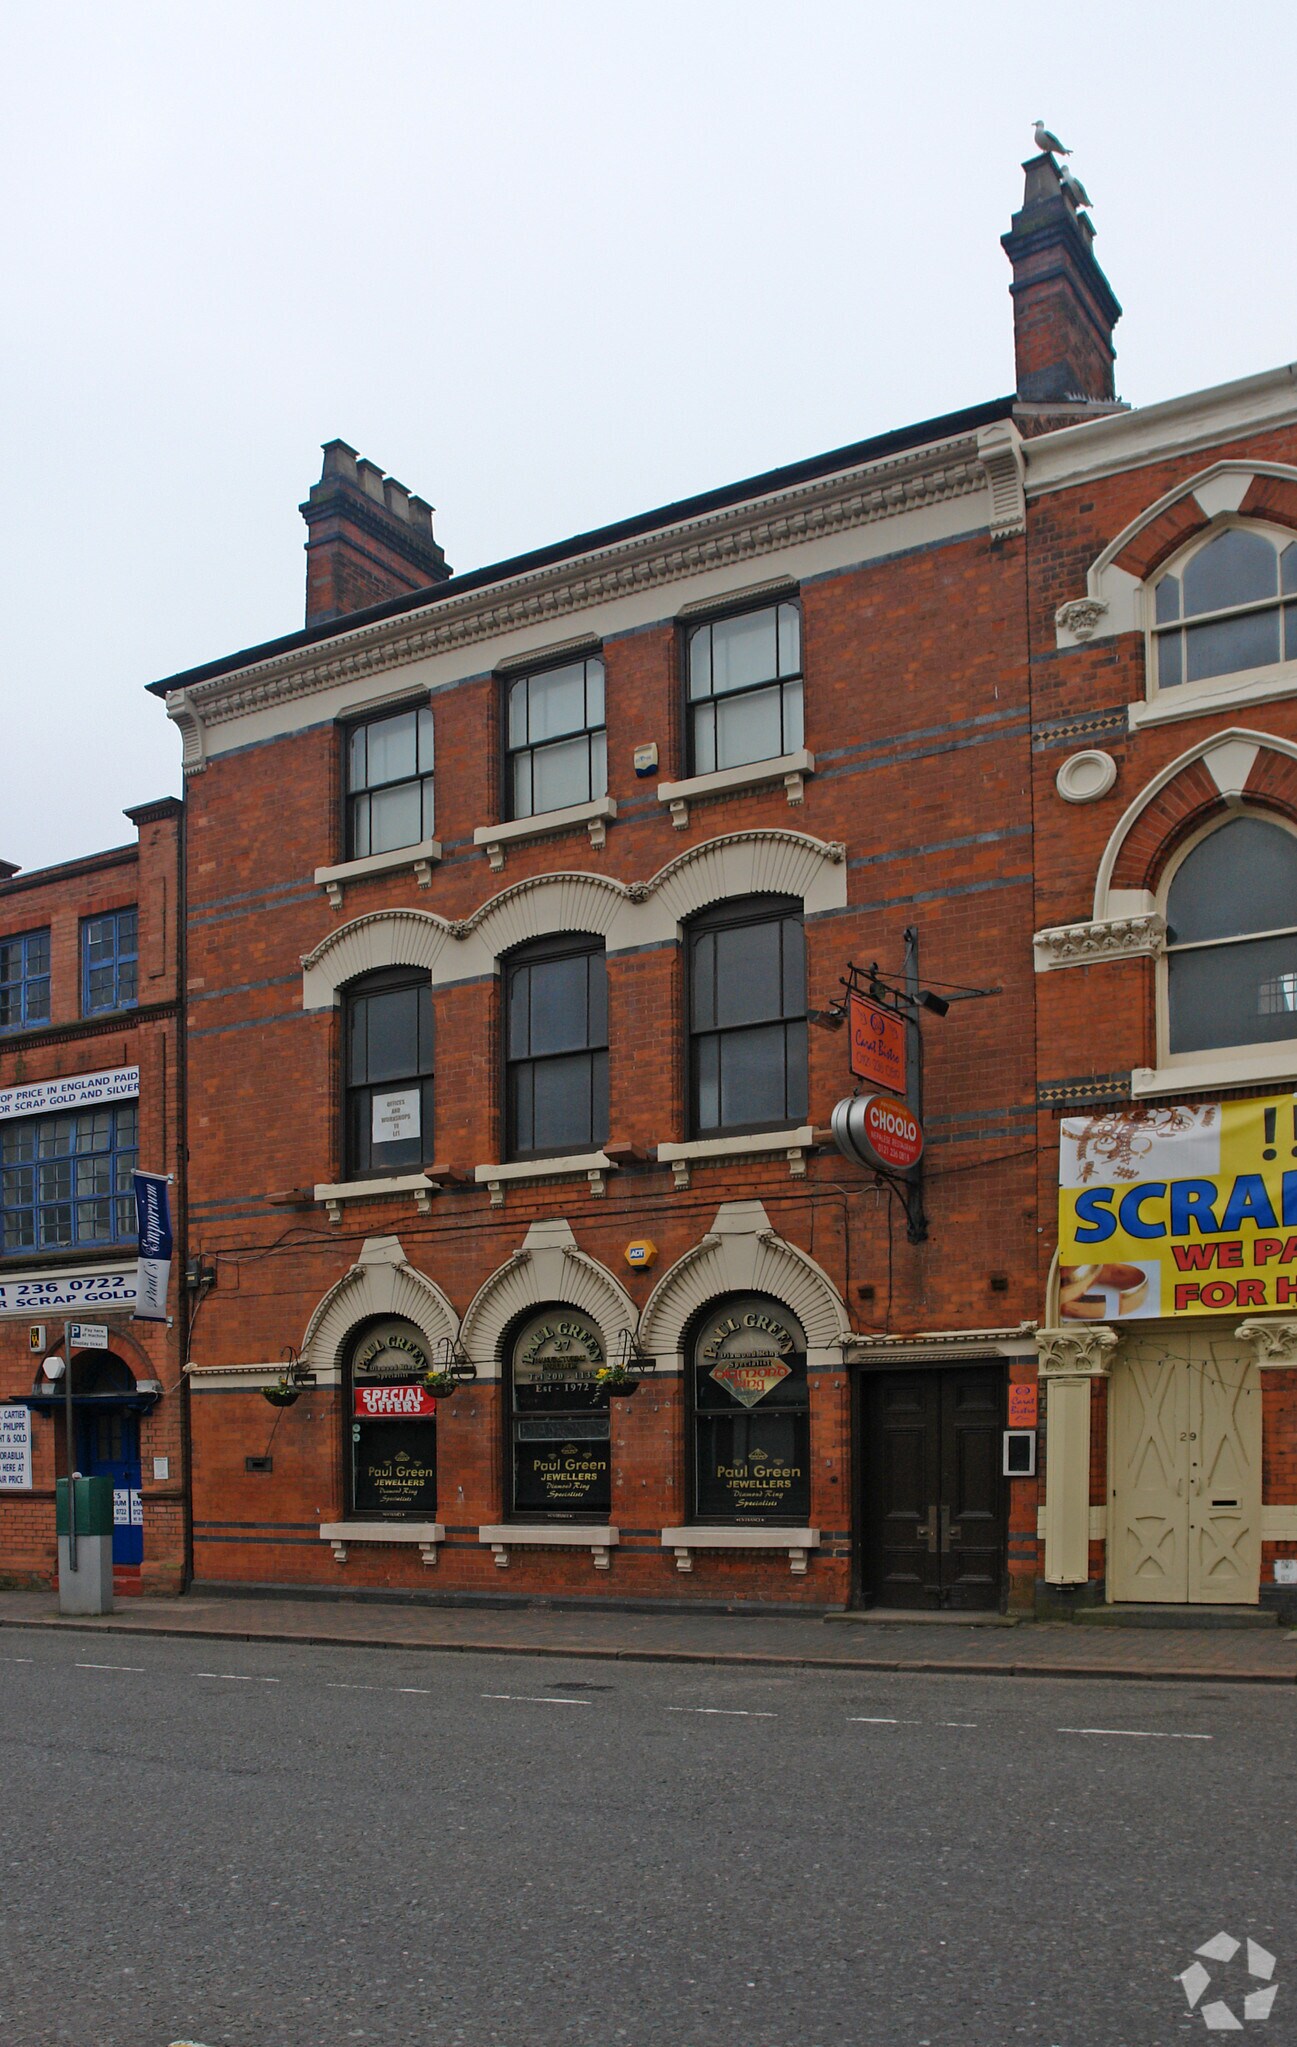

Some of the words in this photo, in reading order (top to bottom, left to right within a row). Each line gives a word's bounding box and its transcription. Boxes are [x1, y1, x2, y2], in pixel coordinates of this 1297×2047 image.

[16, 1088, 43, 1100] PRICE
[47, 1086, 57, 1094] IN
[61, 1077, 110, 1092] ENGLAND
[114, 1072, 138, 1082] PAID
[14, 1099, 46, 1111] SCRAP
[49, 1094, 76, 1105] GOLD
[80, 1089, 103, 1100] AND
[106, 1082, 139, 1096] SILVER
[870, 1106, 917, 1142] CHOOLO
[630, 1249, 644, 1257] ADT
[1171, 1240, 1244, 1272] WE
[18, 1282, 58, 1295] 236
[69, 1276, 125, 1291] 0722
[16, 1294, 77, 1307] SCRAP
[84, 1289, 137, 1301] GOLD
[1174, 1279, 1268, 1311] FOR
[704, 1318, 741, 1359] PAUL
[743, 1313, 796, 1355] GREEN
[523, 1326, 555, 1365] PAUL
[557, 1322, 604, 1362] GREEN
[554, 1339, 571, 1351] 27
[357, 1339, 386, 1372] PAUL
[386, 1335, 428, 1369] GREEN
[728, 1359, 772, 1369] Specialist
[547, 1372, 564, 1380] 200
[535, 1384, 553, 1393] Est
[564, 1383, 590, 1392] 1972
[362, 1388, 424, 1403] SPECIAL
[366, 1400, 421, 1413] OFFERS
[4, 1410, 26, 1419] CARTIER
[3, 1422, 25, 1431] PHILIPPE
[7, 1434, 11, 1443] &
[13, 1434, 27, 1443] SOLD
[1180, 1432, 1197, 1442] 29
[2, 1463, 16, 1472] HERE
[18, 1463, 24, 1472] AT
[533, 1459, 561, 1471] Paul
[564, 1459, 607, 1471] Green
[368, 1466, 392, 1477] Paul
[396, 1466, 433, 1477] Green
[717, 1465, 748, 1478] Paul
[753, 1465, 801, 1478] Green
[8, 1475, 24, 1484] PRICE
[540, 1473, 598, 1481] JEWELLERS
[374, 1479, 425, 1487] JEWELLERS
[573, 1482, 590, 1491] Ring
[726, 1480, 792, 1488] JEWELLERS
[764, 1490, 784, 1499] Ring
[735, 1499, 778, 1507] Specialists
